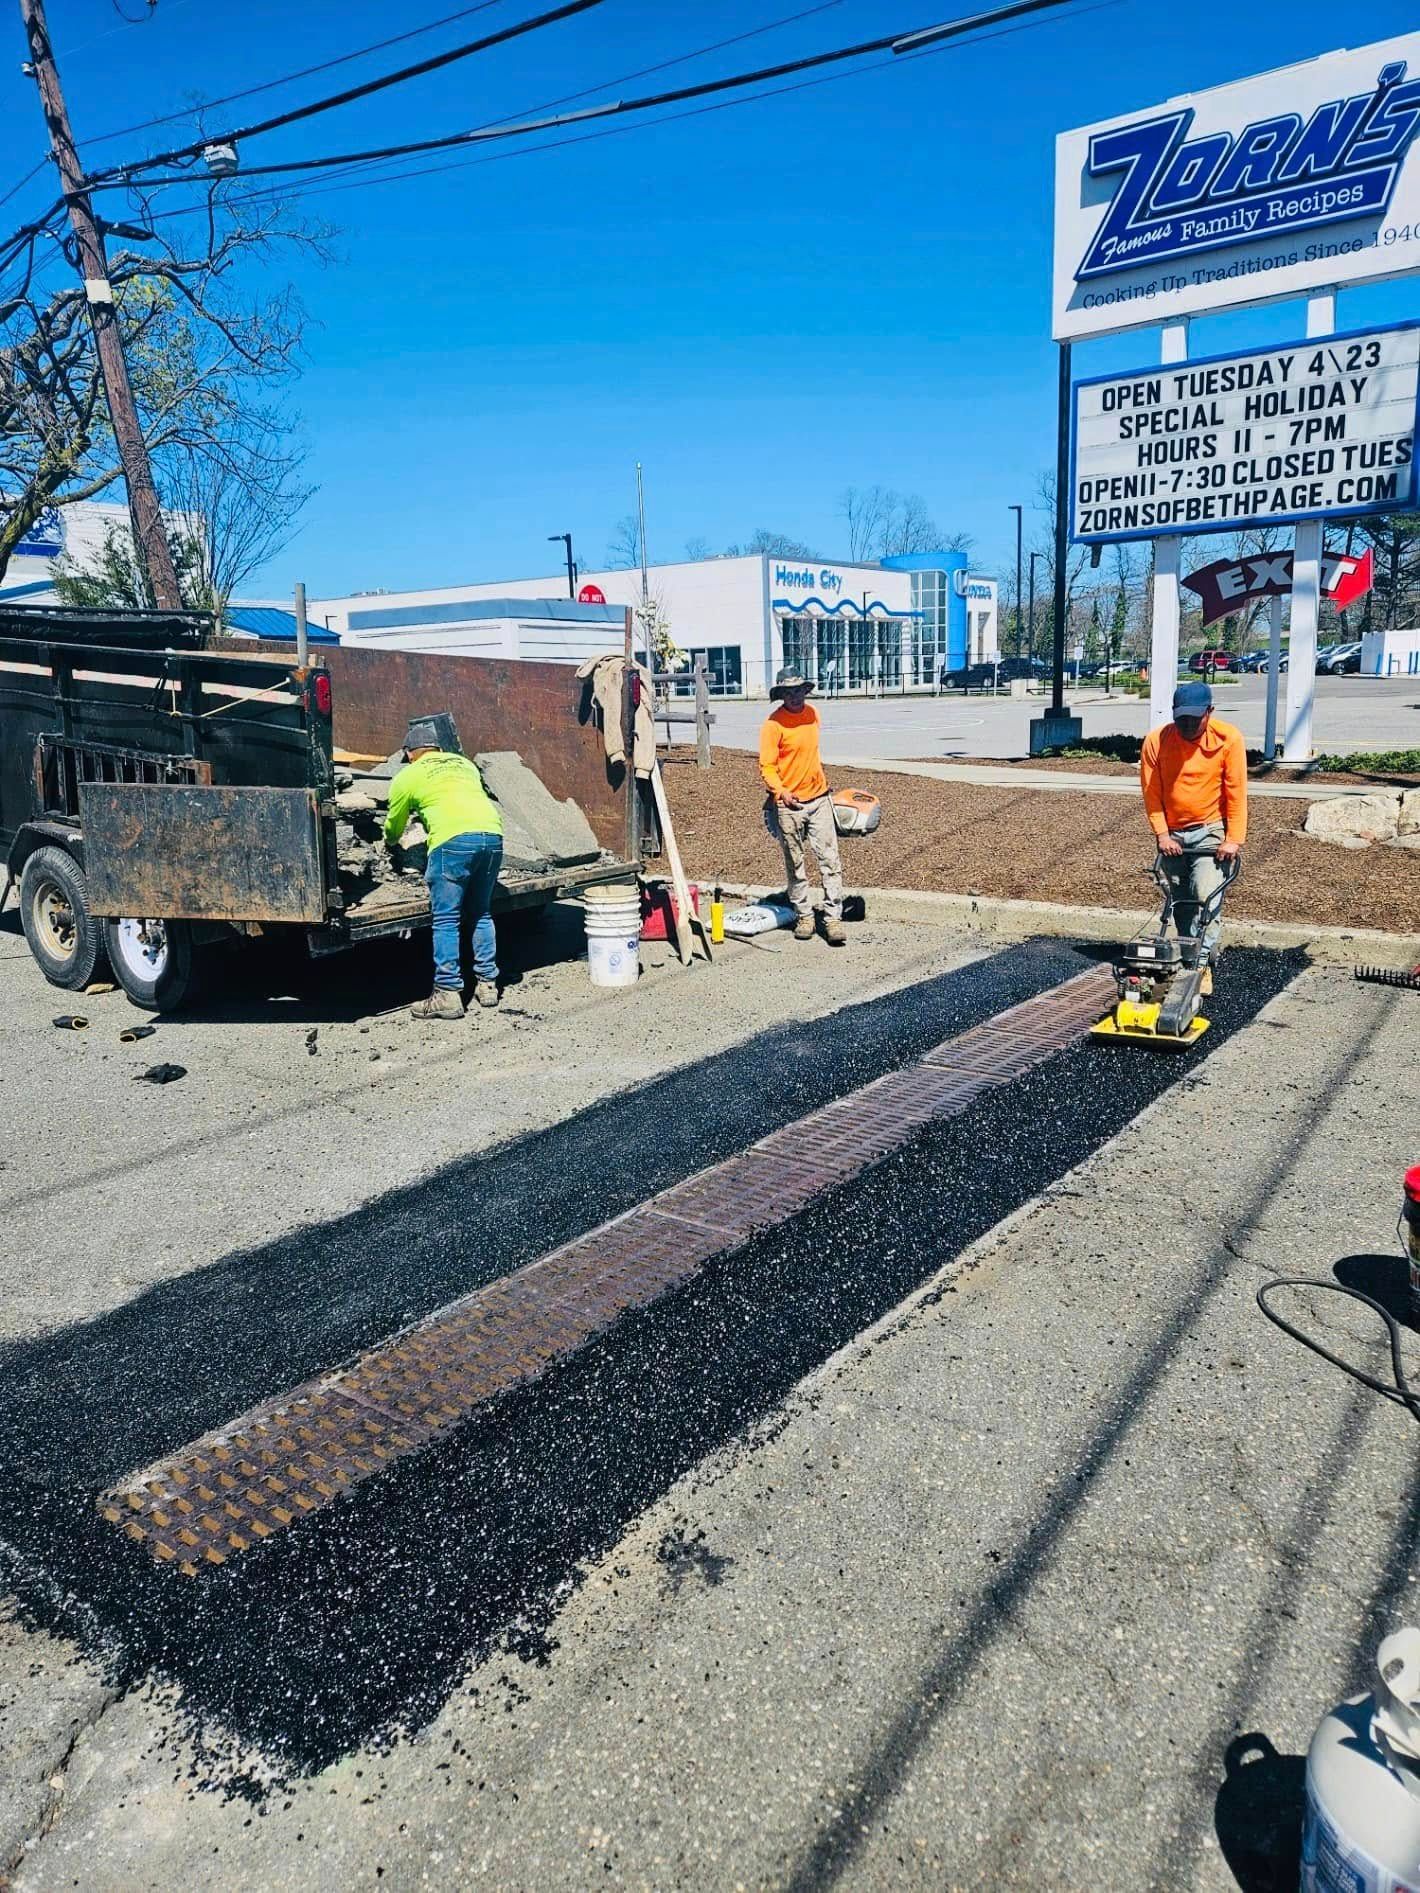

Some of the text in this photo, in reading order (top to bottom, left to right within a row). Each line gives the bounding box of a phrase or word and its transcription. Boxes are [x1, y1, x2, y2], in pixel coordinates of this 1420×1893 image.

[1101, 184, 1364, 264] Famous Family Recipes
[1083, 279, 1157, 311] Cooking
[1161, 276, 1188, 294] Up
[1192, 251, 1298, 286] Traditions
[1304, 238, 1364, 263] Since
[1102, 380, 1161, 412] OPEN
[1174, 356, 1294, 400] TUESDAY
[1119, 377, 1368, 440] SPECIAL HOLIDAY
[1137, 434, 1217, 467] HOURS
[1289, 414, 1346, 446] 7PM
[1232, 449, 1334, 486] CLOSED
[1342, 438, 1412, 471] TUES
[1079, 473, 1398, 533] ZORNSOFBETHPAGE.COM
[775, 564, 843, 594] Honda City
[1215, 557, 1357, 600] EXT
